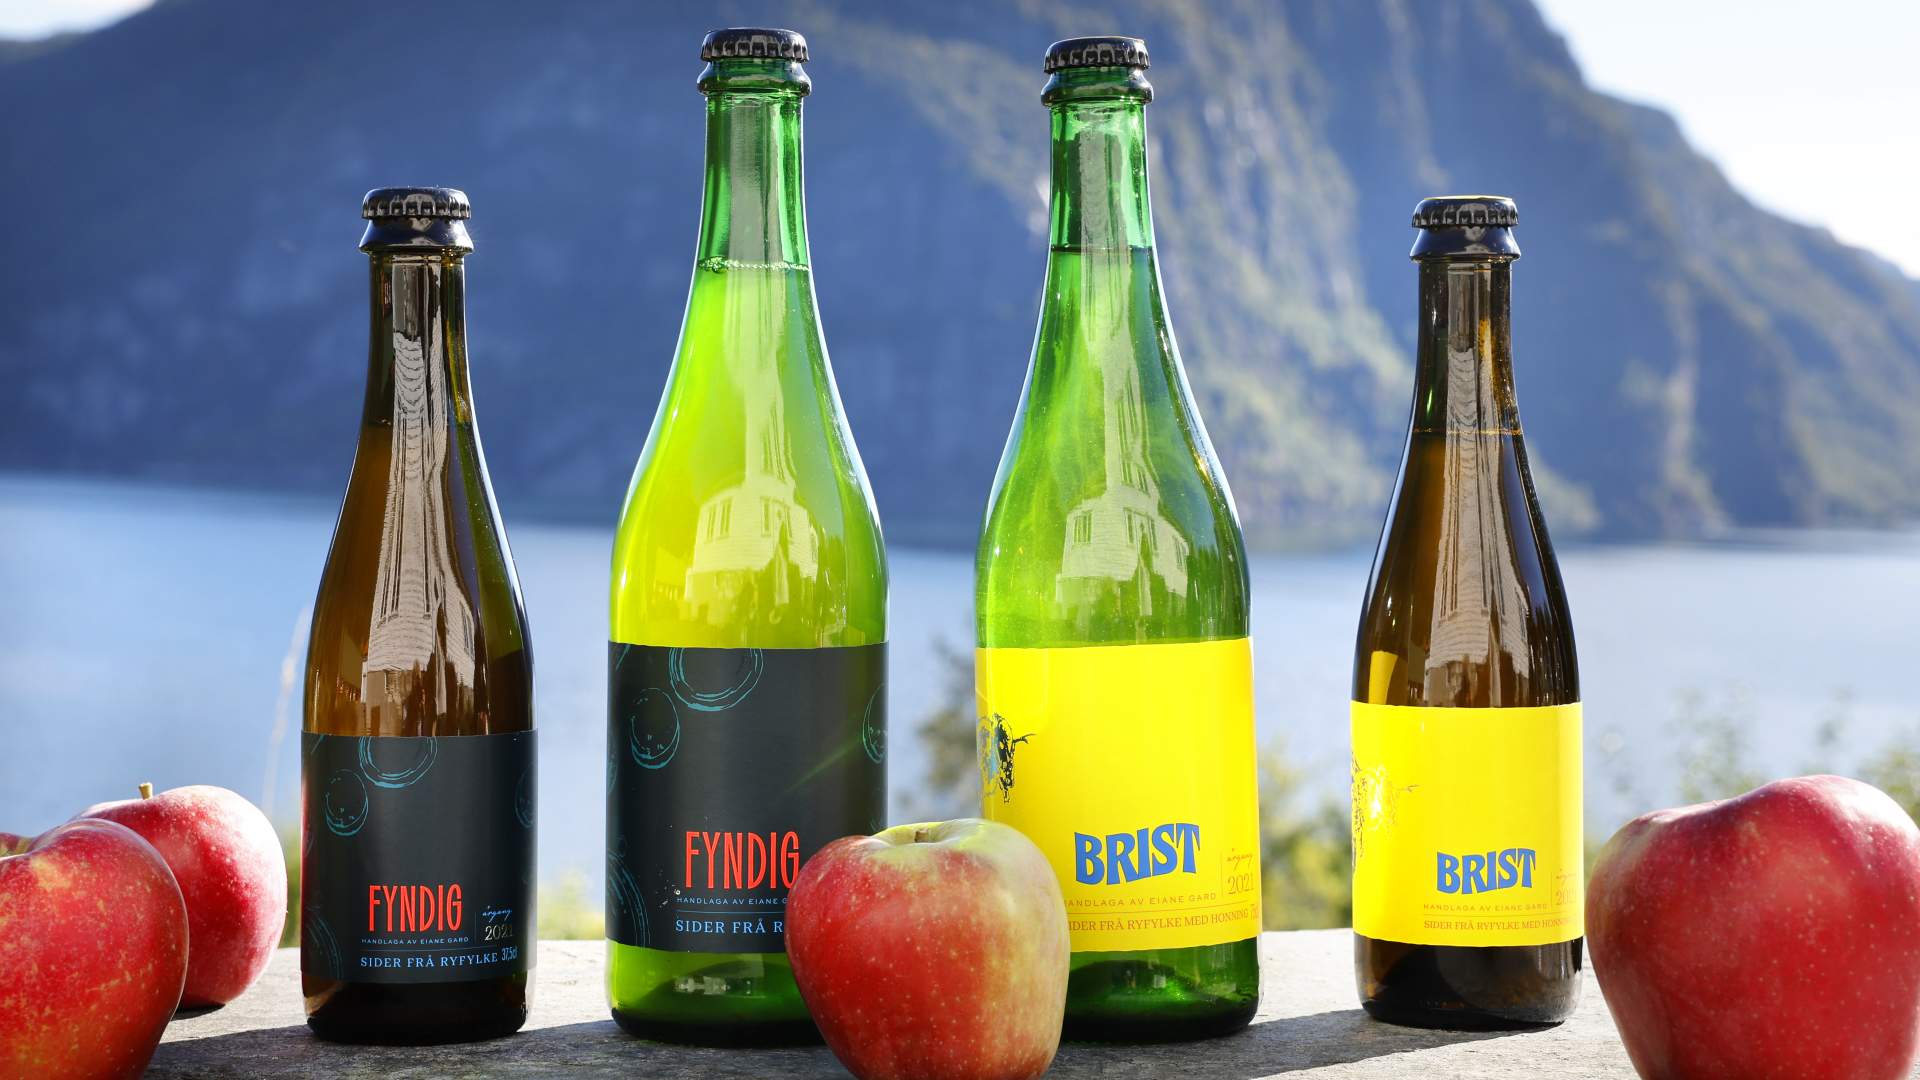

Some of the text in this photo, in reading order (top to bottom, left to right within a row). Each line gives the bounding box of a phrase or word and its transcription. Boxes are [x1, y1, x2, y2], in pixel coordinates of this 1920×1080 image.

[685, 831, 800, 889] FYNDIG
[1074, 822, 1201, 886] BRIST
[1436, 848, 1536, 895] BRIST
[676, 896, 728, 905] HANDLAGA
[1065, 892, 1217, 907] ANDLAGA AV EIANE GARD
[369, 884, 462, 932] FYNDIG
[675, 919, 725, 933] SIDER
[732, 918, 766, 934] FRÅ
[1069, 919, 1096, 931] IDER
[1100, 919, 1125, 931] FRÅ
[1127, 918, 1182, 930] RYFYLKE
[1184, 916, 1209, 927] MED
[1211, 908, 1249, 924] HONNING
[1423, 920, 1452, 929] SIDER
[1522, 920, 1540, 929] MED
[361, 937, 404, 945] HANDLAGA
[420, 937, 444, 945] EIANE
[360, 957, 401, 967] SIDER
[407, 955, 434, 968] FRÅ
[440, 952, 498, 967] RYFYLKE
